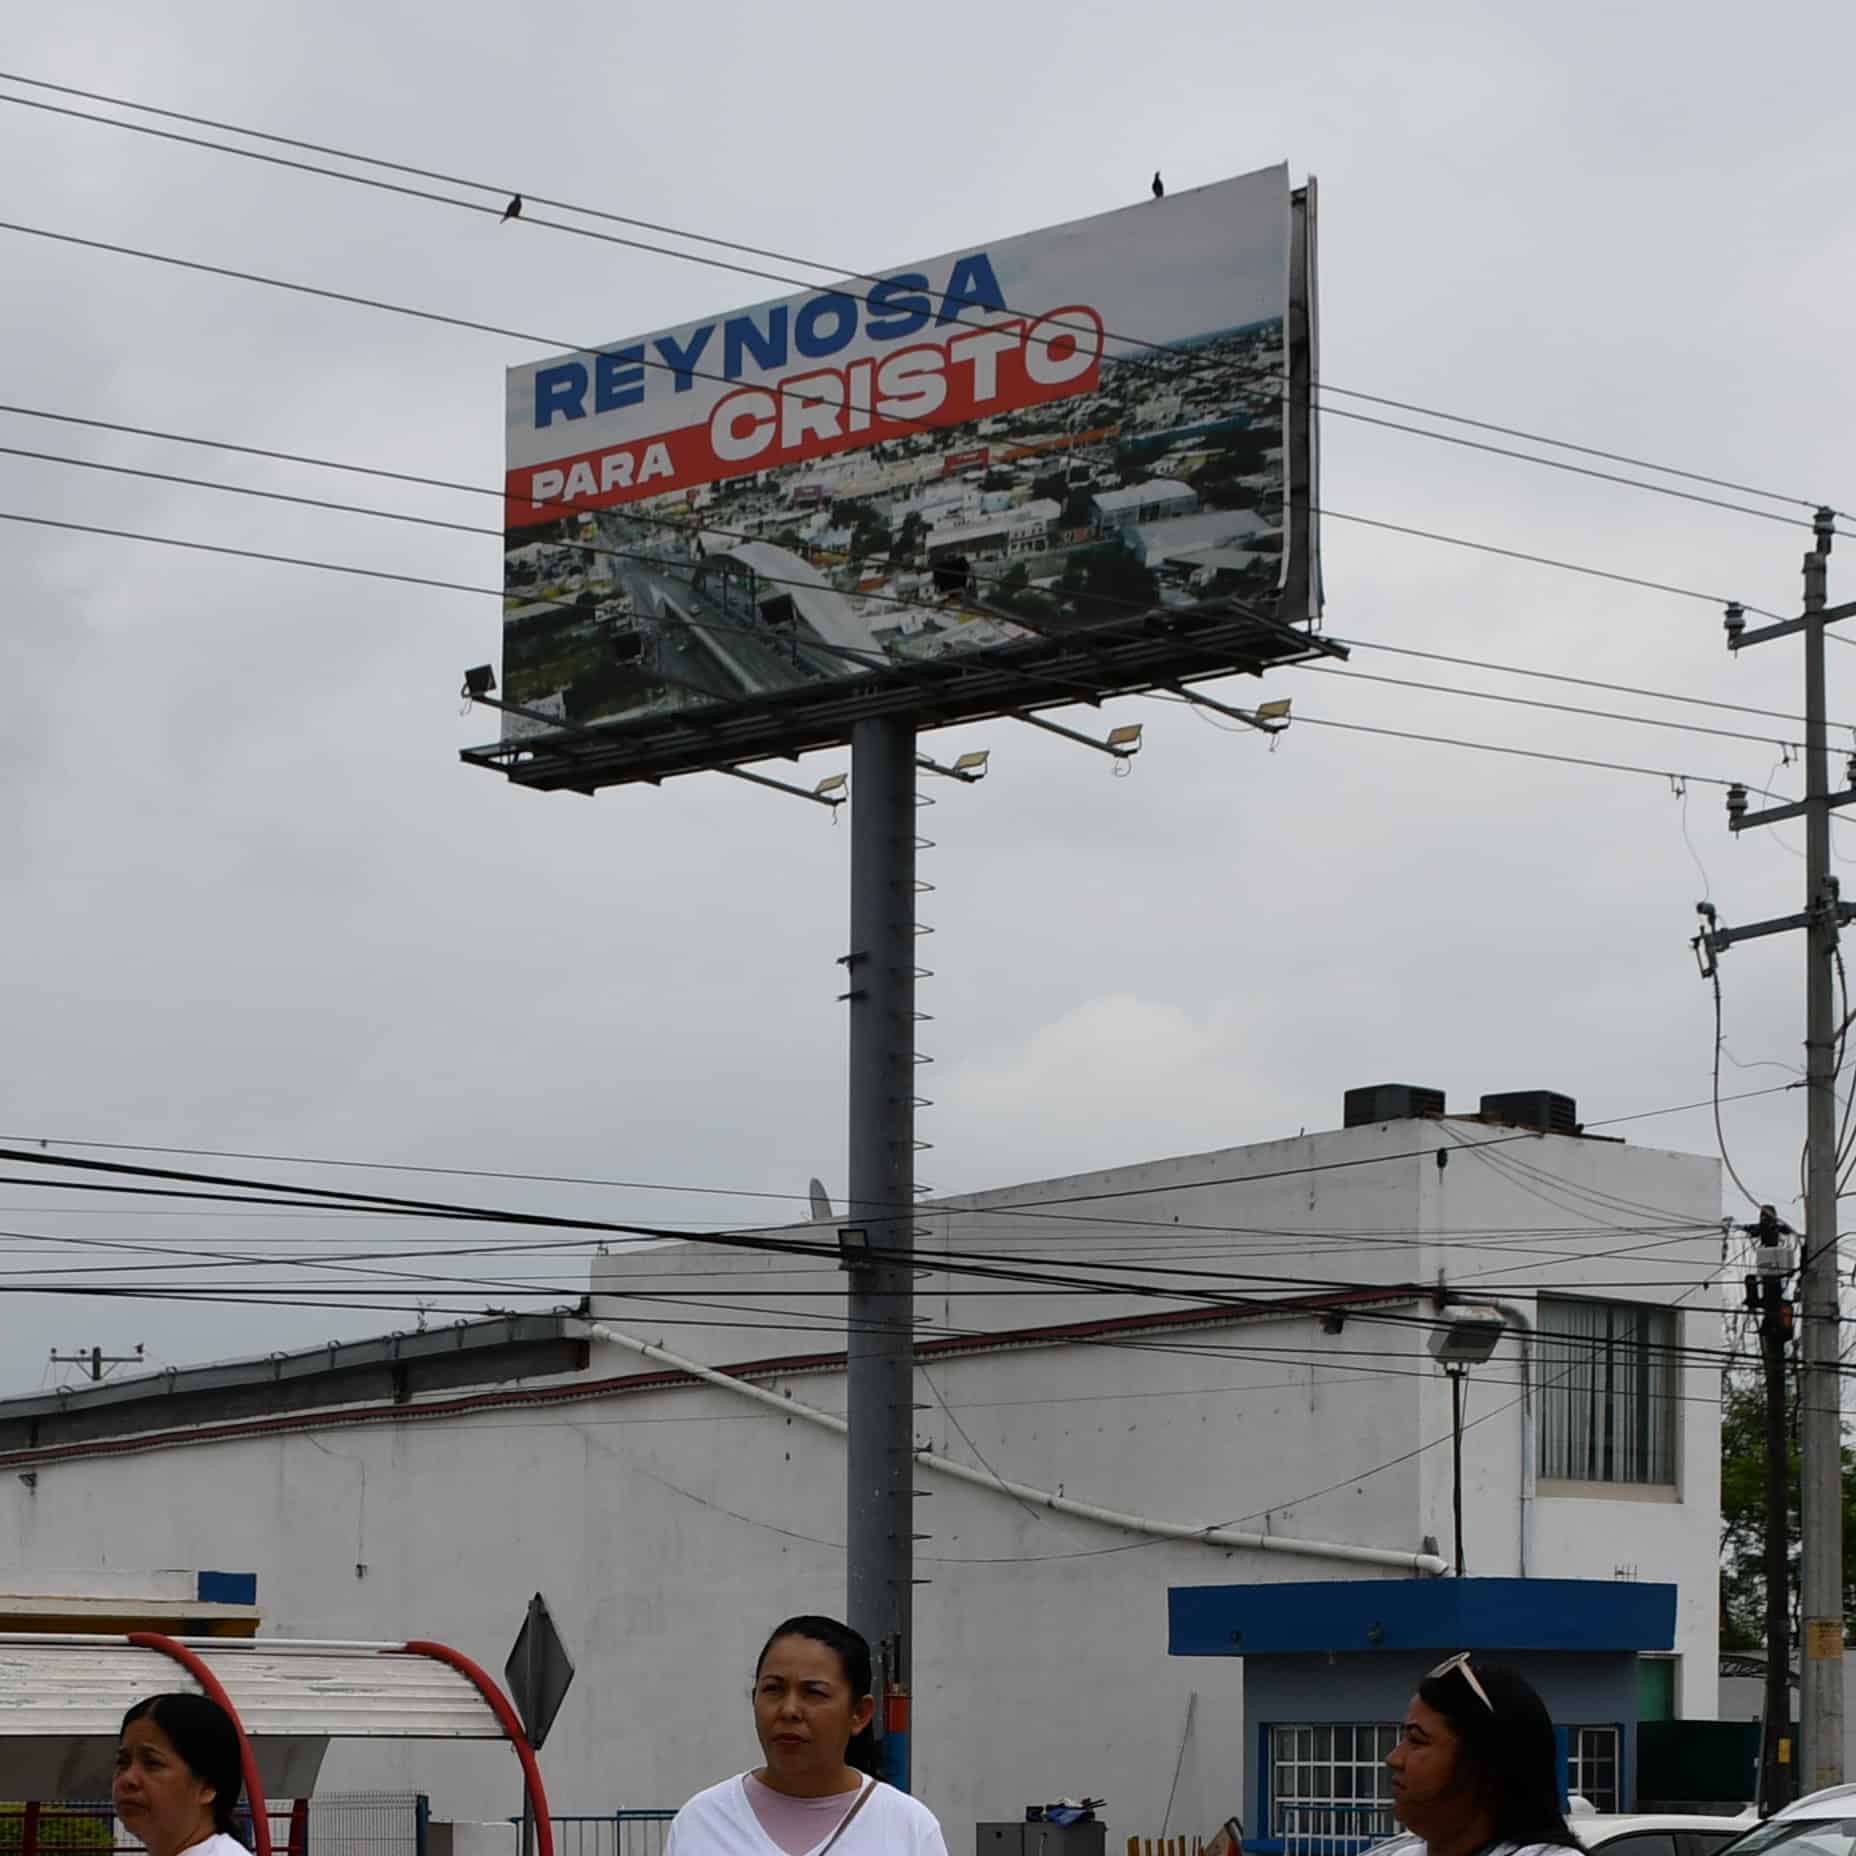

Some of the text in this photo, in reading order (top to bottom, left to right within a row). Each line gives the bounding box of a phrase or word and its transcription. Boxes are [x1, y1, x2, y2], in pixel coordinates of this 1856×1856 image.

[531, 307, 1103, 510] PARA CRISTO
[534, 251, 1008, 429] REYNOSA
